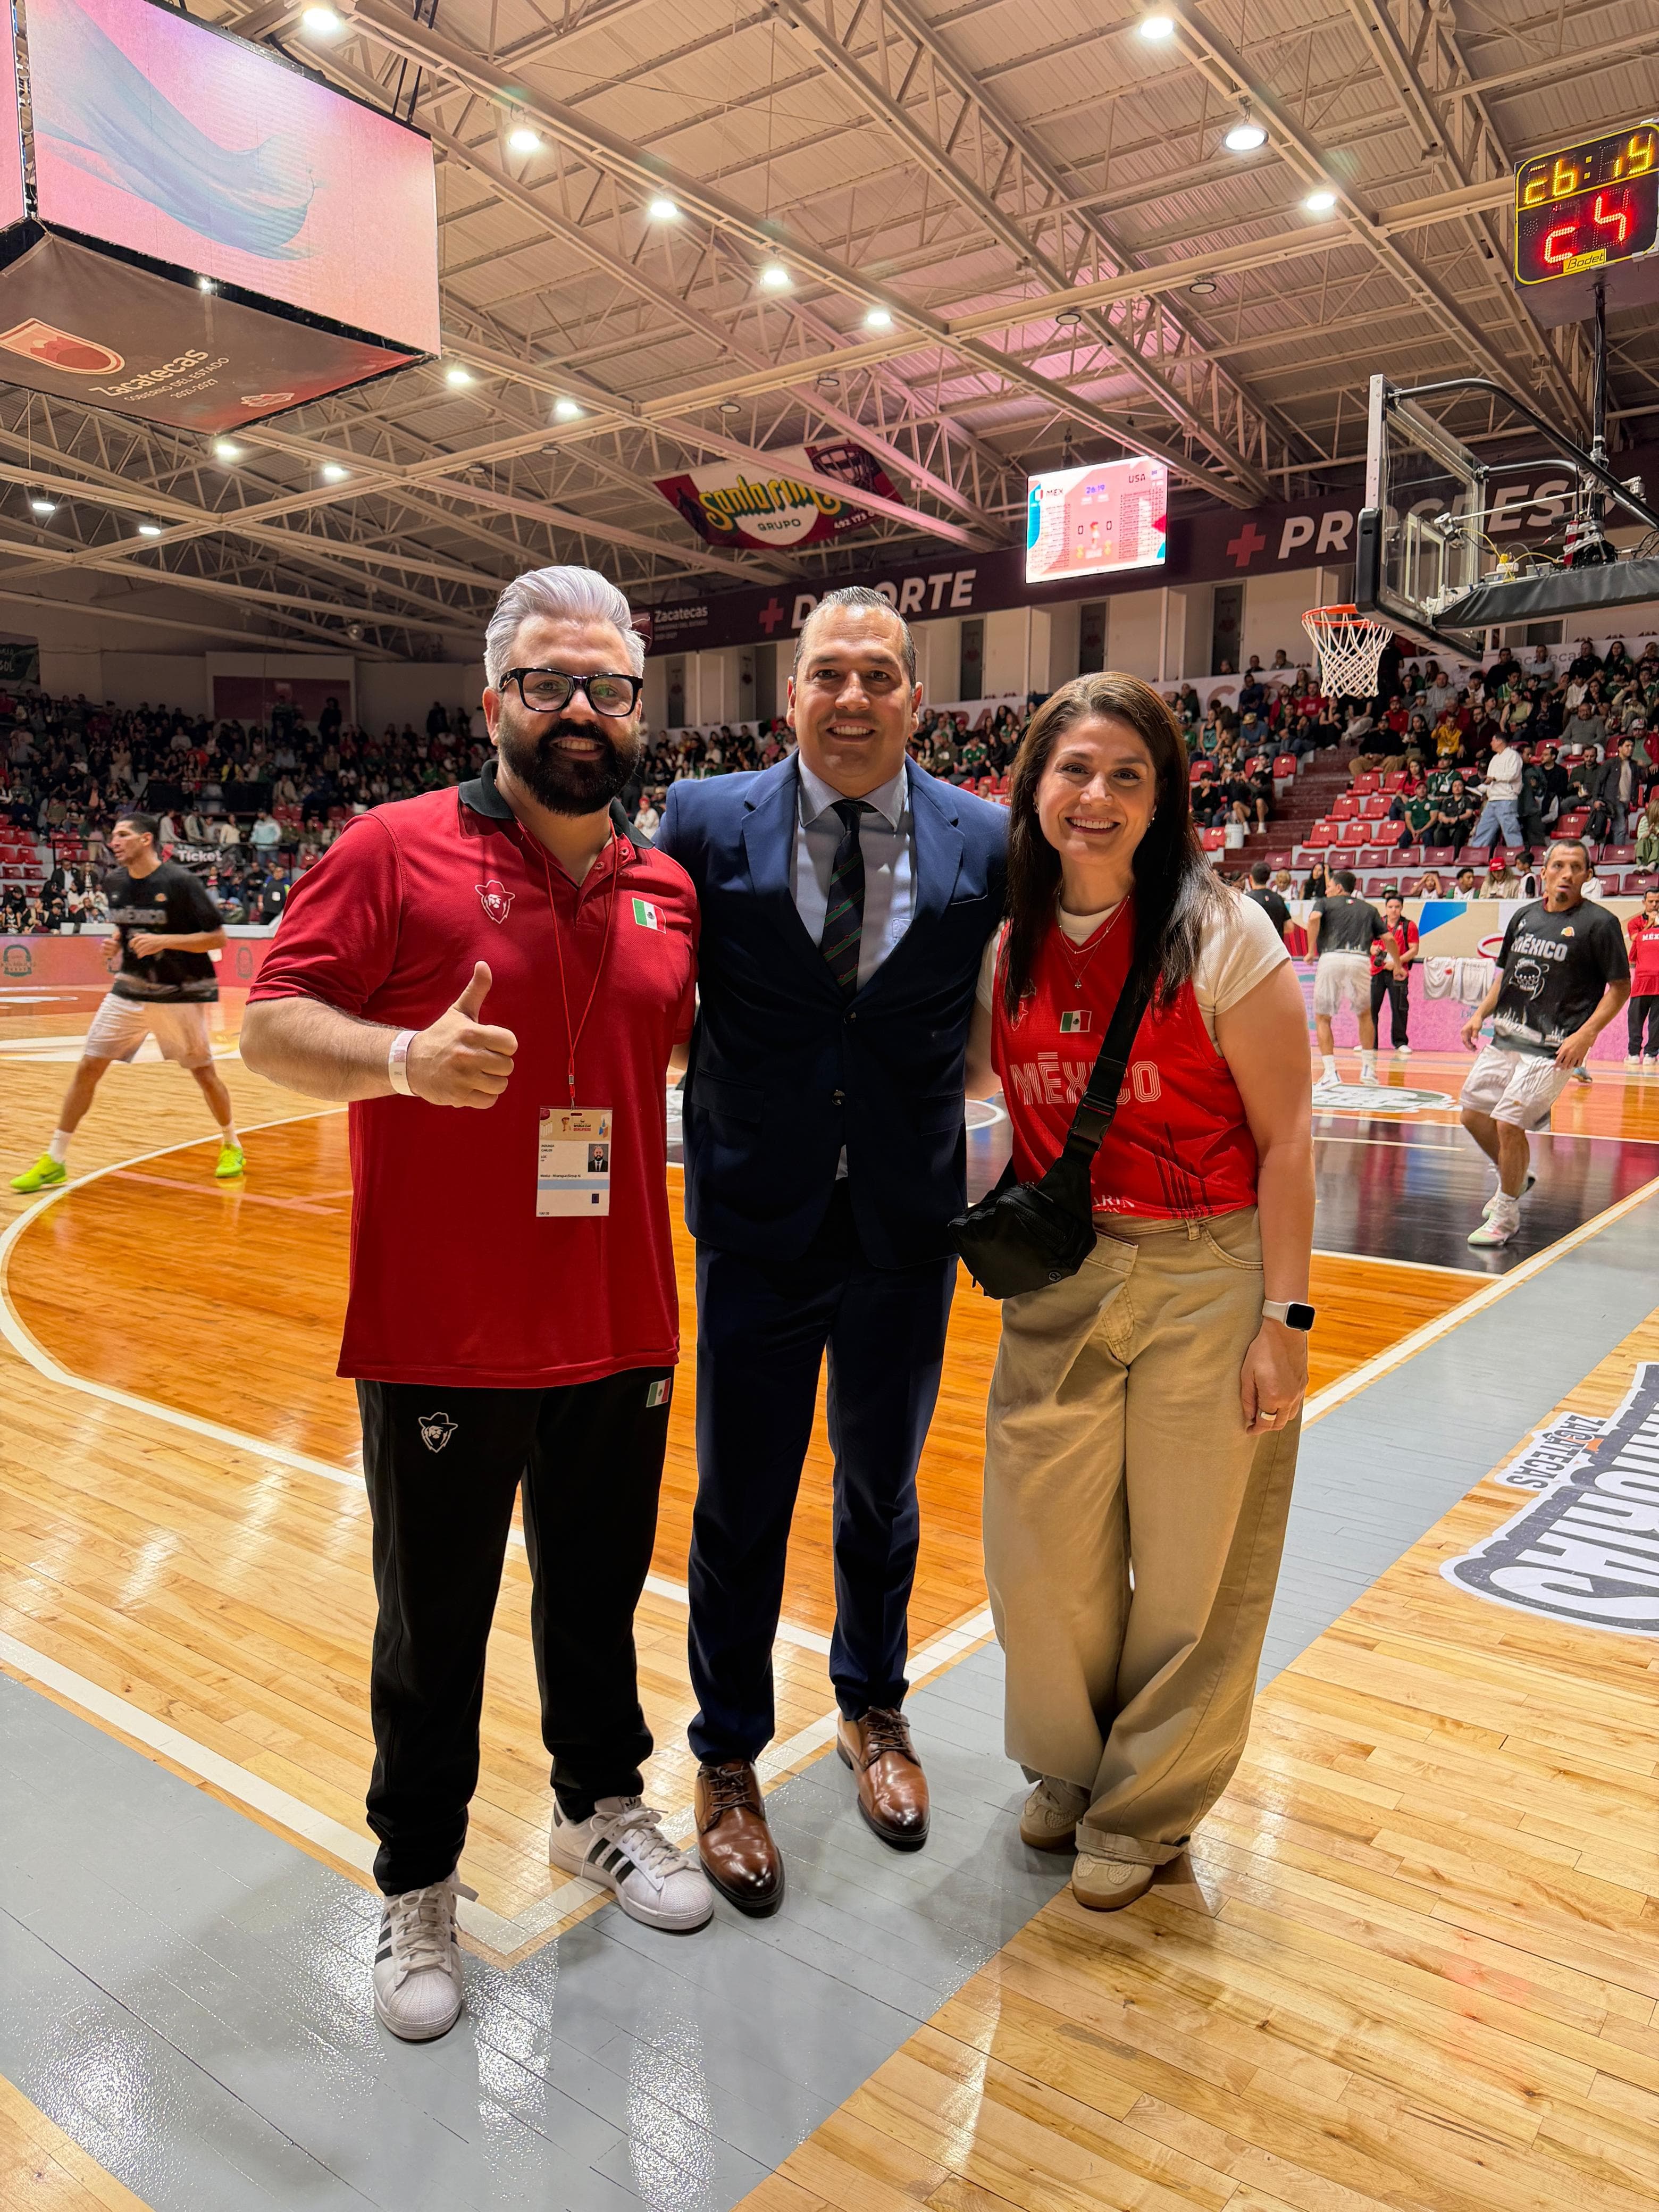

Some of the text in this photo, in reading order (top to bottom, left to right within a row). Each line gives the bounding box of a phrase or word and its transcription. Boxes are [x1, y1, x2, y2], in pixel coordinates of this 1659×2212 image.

[1567, 254, 1604, 270] Bodet
[88, 349, 208, 396] Zacatecas
[124, 357, 229, 401] GOBIERNO DEL ESTADO
[170, 378, 219, 398] 2021-2027
[1128, 473, 1145, 483] USA
[1046, 488, 1063, 497] MEX
[758, 518, 800, 531] GRUPO
[1078, 521, 1112, 535] 0 0
[655, 606, 708, 624] Zacatecas
[178, 850, 222, 862] Ticket
[1511, 933, 1568, 962] MÉXICO
[1010, 1052, 1161, 1105] MÉXO
[1506, 1415, 1607, 1488] ZACATECAS
